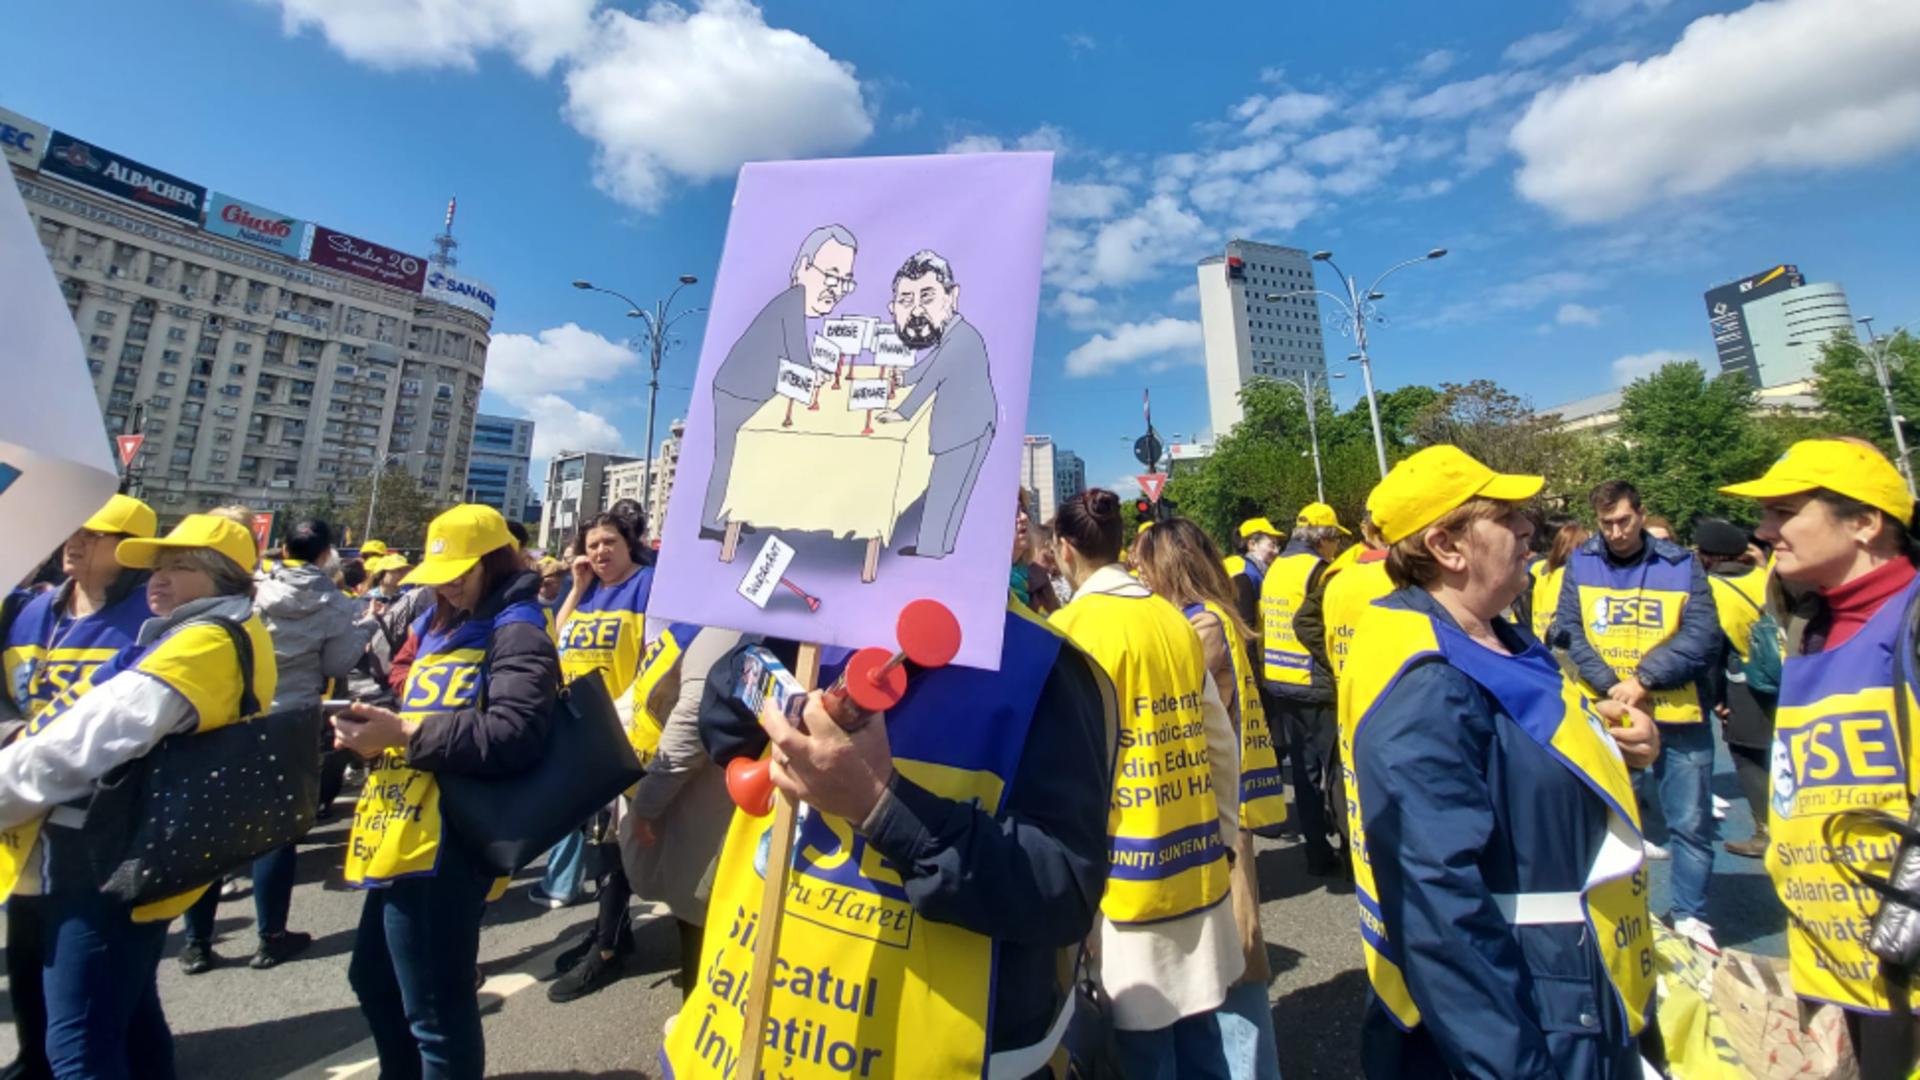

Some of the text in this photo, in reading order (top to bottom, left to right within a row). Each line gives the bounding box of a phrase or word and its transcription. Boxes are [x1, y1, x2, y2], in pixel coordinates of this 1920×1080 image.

[0, 122, 35, 153] EC
[103, 160, 198, 209] ALBACHER
[328, 234, 383, 263] Studio
[1608, 598, 1661, 626] FSE
[569, 620, 618, 648] FSE
[1123, 757, 1162, 778] din
[1791, 718, 1897, 786] FSE
[817, 887, 908, 931] Haret
[1615, 914, 1642, 949] din
